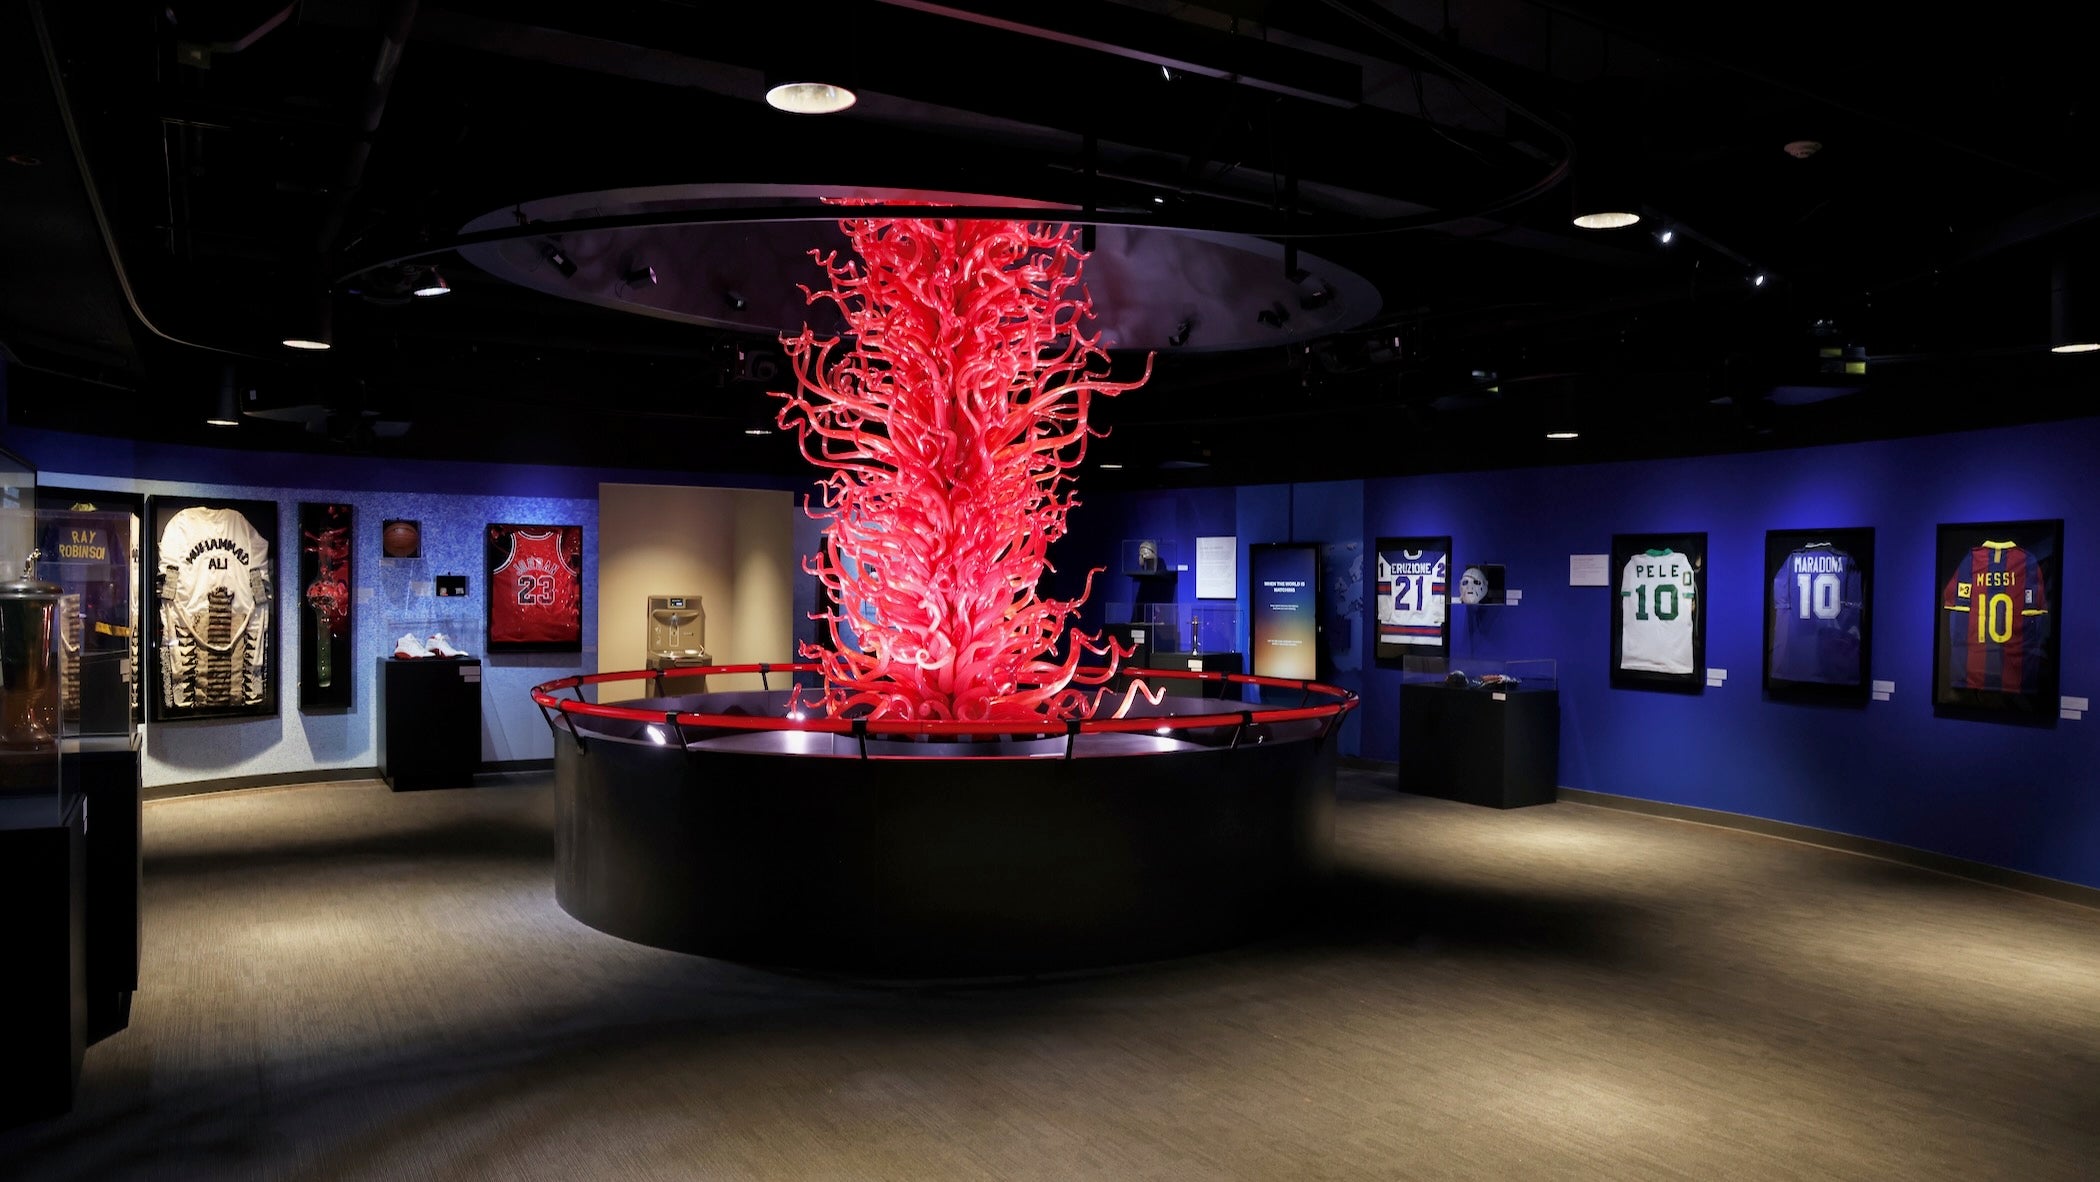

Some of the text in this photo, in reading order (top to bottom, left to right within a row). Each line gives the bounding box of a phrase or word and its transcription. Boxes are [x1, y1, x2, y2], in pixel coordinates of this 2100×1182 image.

[71, 530, 96, 544] RAY
[185, 538, 249, 566] MUHAMMAD
[208, 558, 228, 570] ALI
[1391, 563, 1432, 574] ERUZIONE
[1636, 564, 1679, 578] PELE
[1794, 556, 1844, 573] MARADONA
[518, 574, 556, 605] 23
[1976, 571, 2016, 587] MESSI
[1395, 576, 1424, 611] 21
[1635, 584, 1678, 620] 10
[1797, 573, 1841, 620] 10
[1978, 592, 2014, 644] 10
